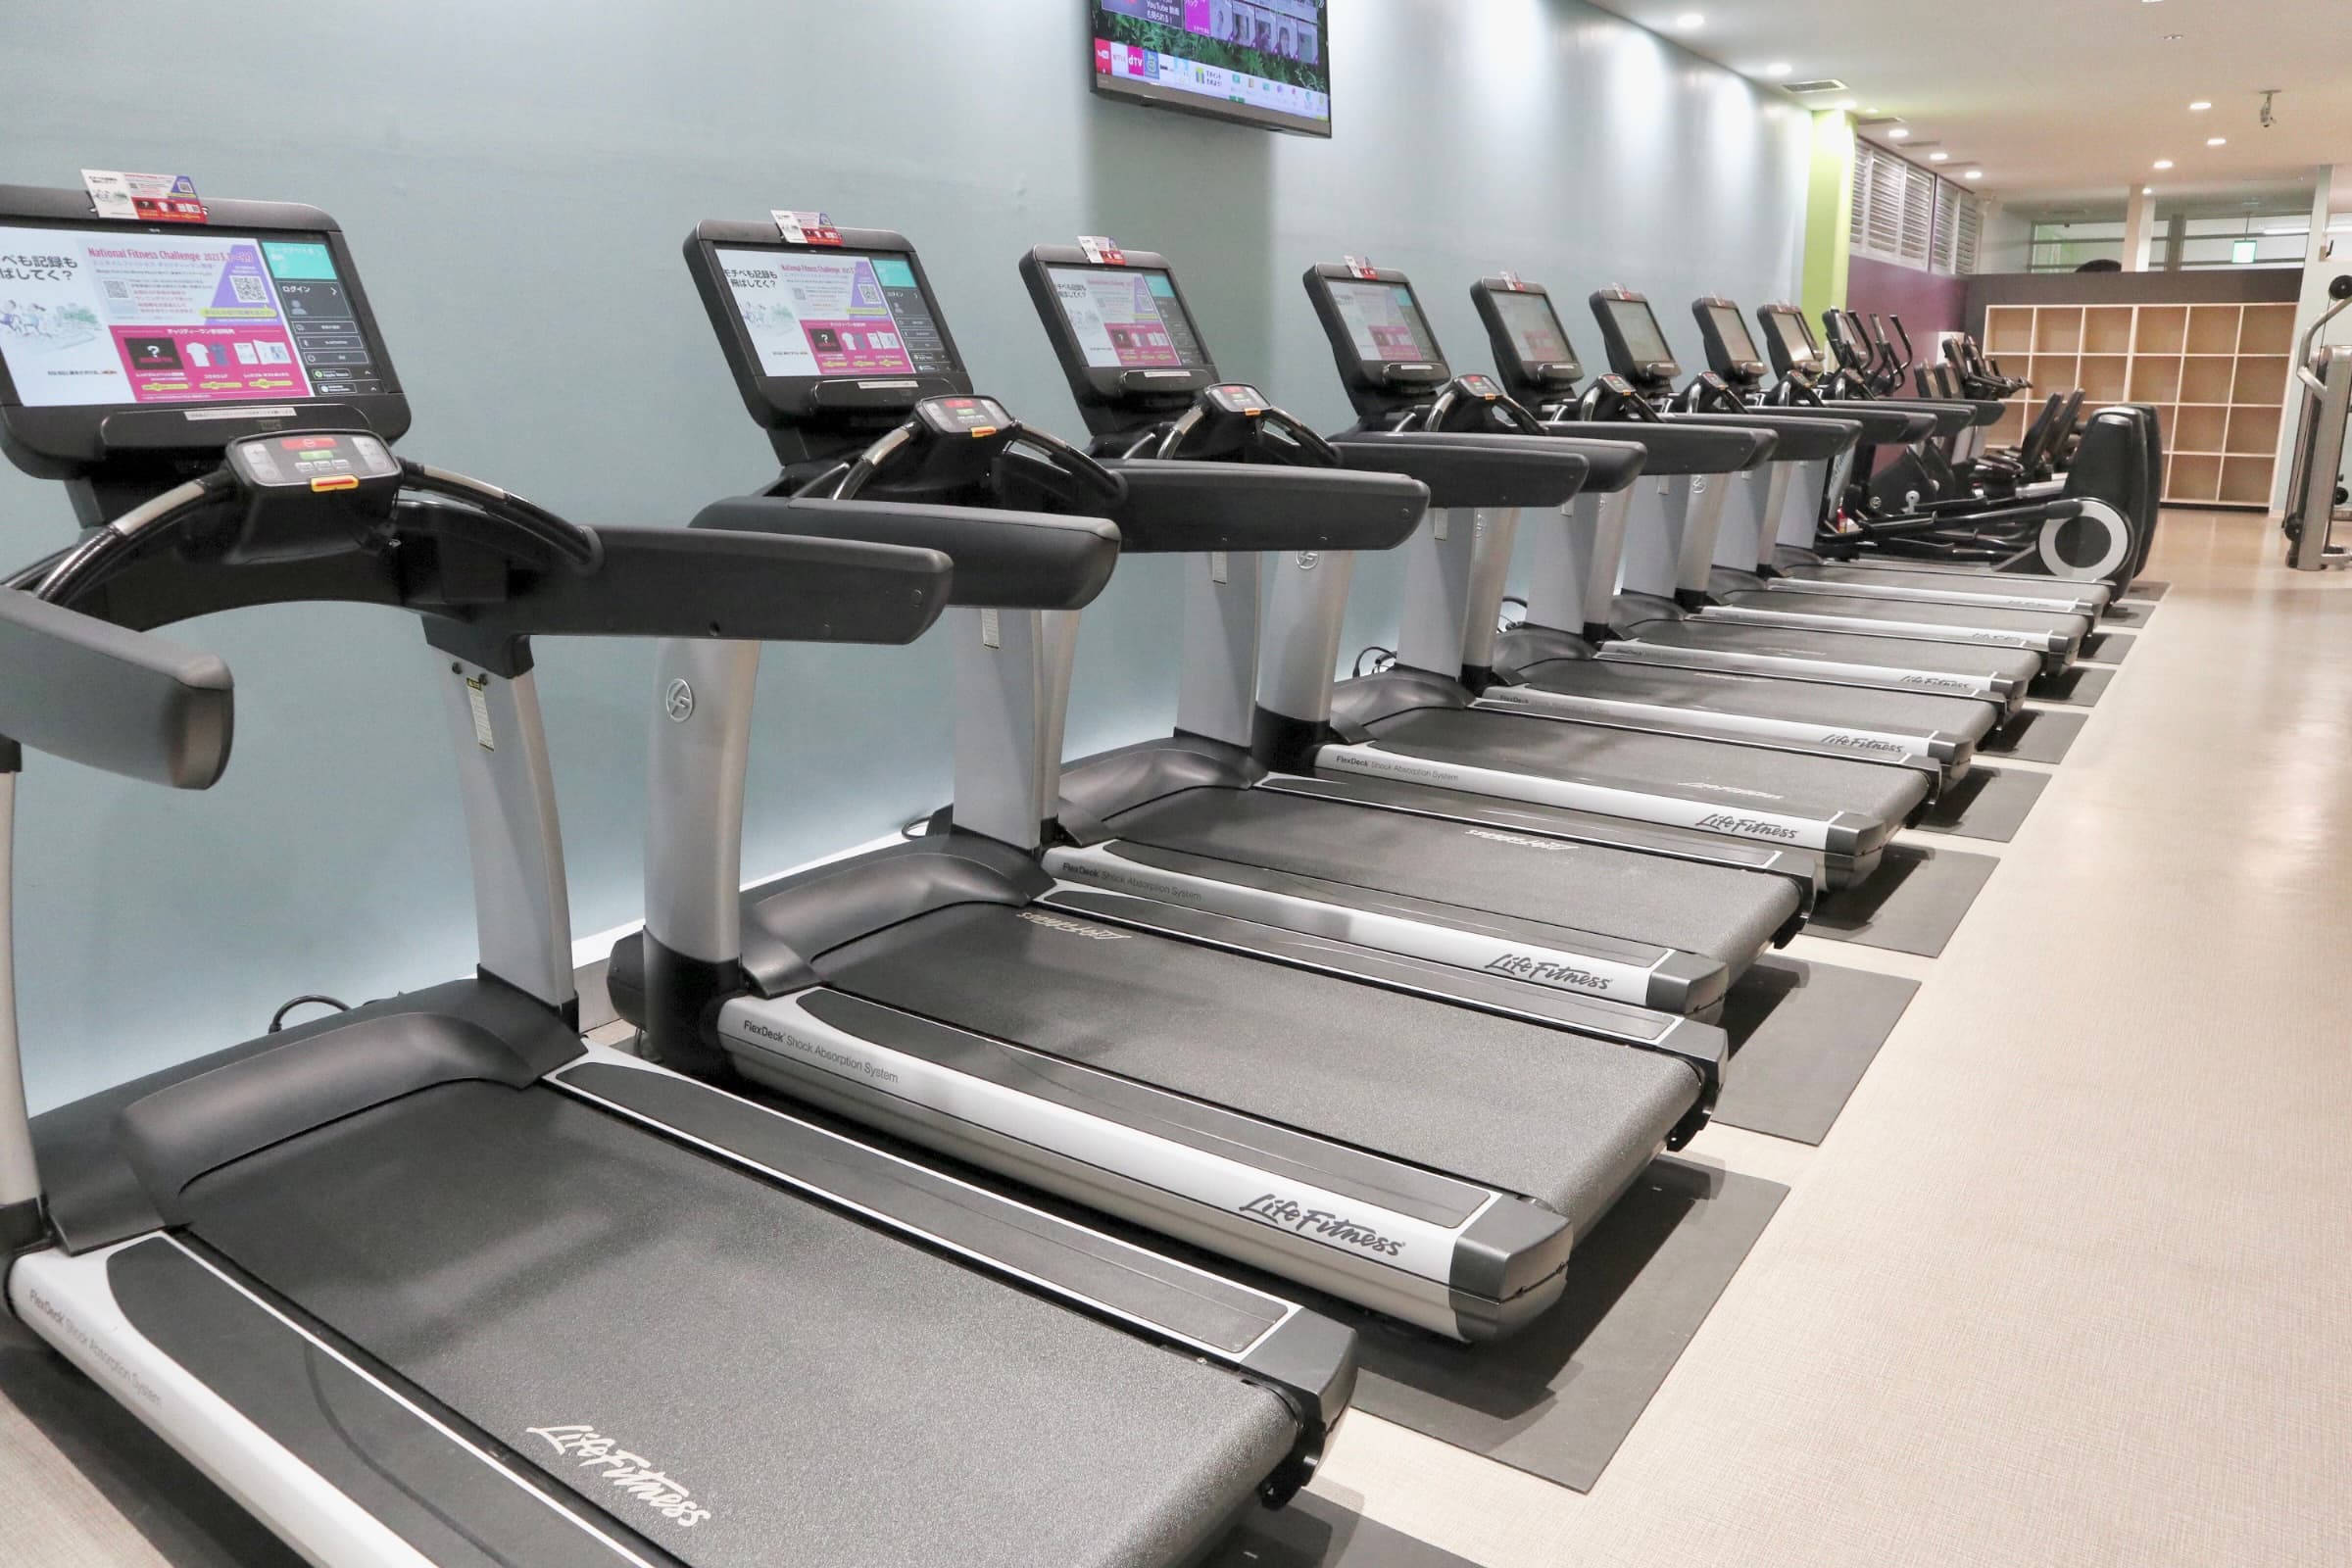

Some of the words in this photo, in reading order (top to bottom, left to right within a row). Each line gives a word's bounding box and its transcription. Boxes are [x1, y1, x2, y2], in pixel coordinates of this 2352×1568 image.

[1128, 55, 1143, 68] dTV
[87, 247, 126, 259] National
[126, 249, 159, 260] Fitness
[159, 250, 201, 263] Challenge
[282, 284, 311, 293] ログイン
[1336, 755, 1368, 767] FlexDeck
[1694, 813, 1735, 831] Life
[1731, 818, 1799, 839] Fitness
[1062, 862, 1099, 877] FlexDeck
[1102, 870, 1125, 884] Shock
[1126, 877, 1170, 894] Absorption
[1170, 886, 1202, 902] System
[1484, 954, 1533, 975] Life
[1528, 961, 1611, 990] Fitness
[744, 1019, 784, 1042] FlexDeck
[786, 1035, 813, 1054] Shock
[814, 1045, 862, 1070] Absorption
[863, 1061, 899, 1083] System
[1239, 1193, 1300, 1225] Life
[1296, 1208, 1403, 1256] Fitness
[28, 1289, 65, 1324] FlexDeck
[526, 1425, 615, 1457] Life
[579, 1448, 711, 1528] Fitness
